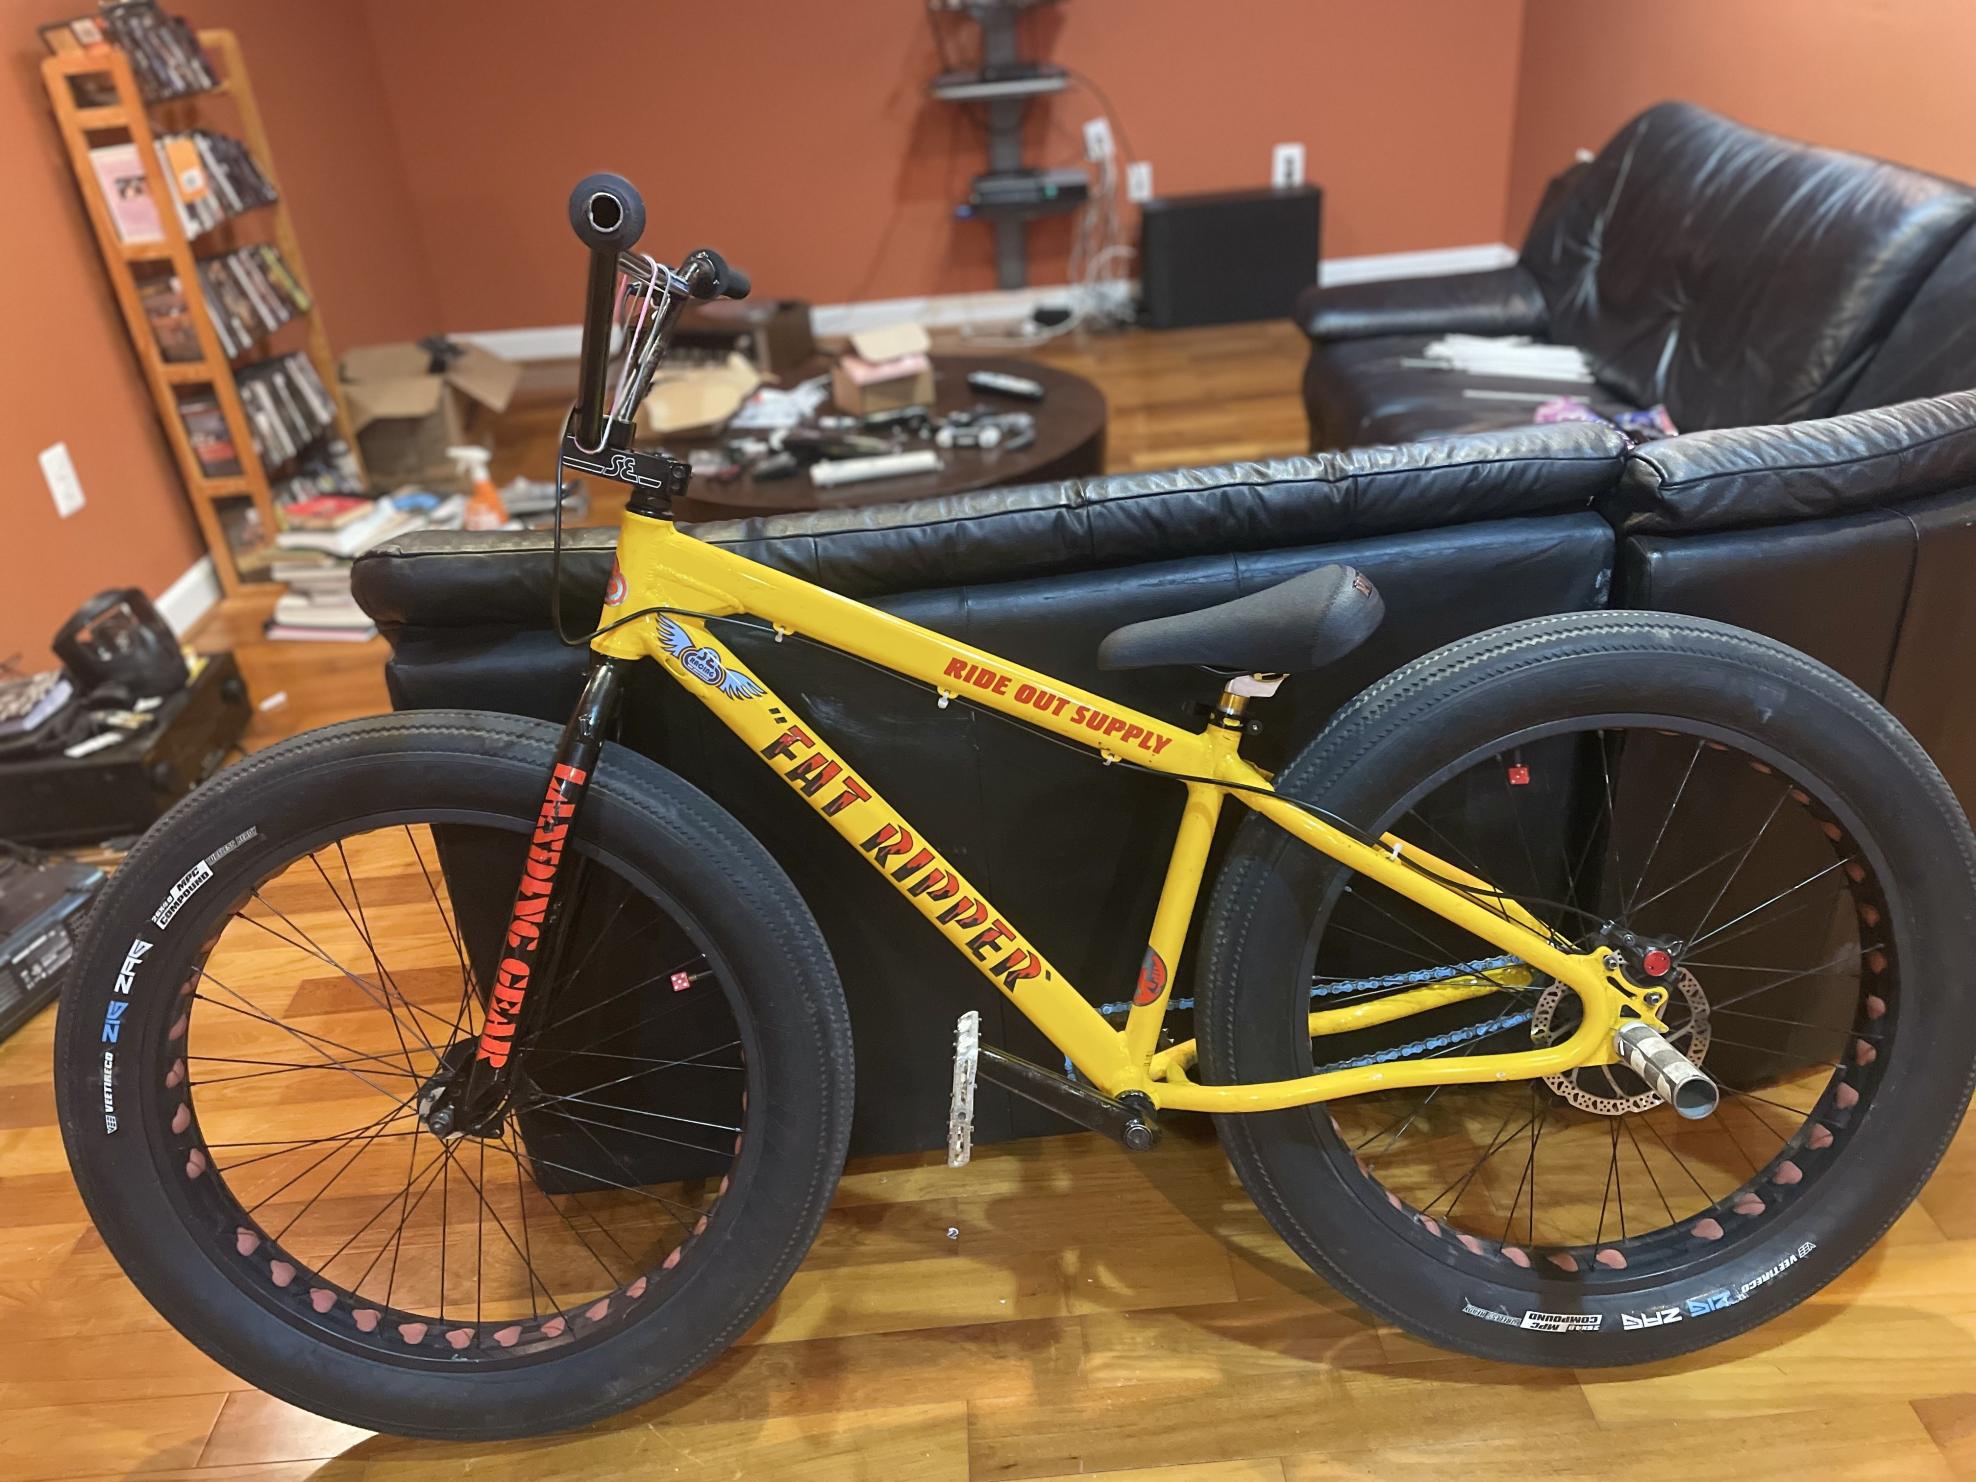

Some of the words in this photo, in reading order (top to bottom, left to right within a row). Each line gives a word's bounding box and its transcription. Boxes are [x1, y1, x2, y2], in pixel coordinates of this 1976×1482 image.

[602, 454, 639, 483] SE
[689, 656, 714, 678] RACING
[943, 657, 1012, 695] RIDE
[1014, 683, 1071, 717] OUT
[1070, 706, 1173, 755] SUPPLY
[507, 763, 588, 951] LANDING
[158, 870, 211, 927] COMPOUND
[176, 866, 201, 892] MPC
[113, 938, 154, 995] ZAG
[101, 1000, 129, 1043] ZIG
[476, 957, 531, 1068] GEAR
[104, 1051, 115, 1114] VEETIRECO
[1741, 1254, 1798, 1294] VEETIRECO
[1527, 1312, 1599, 1324] COMPOUND
[1621, 1306, 1683, 1331] ZAG
[1686, 1289, 1735, 1318] ZIG
[1529, 1322, 1560, 1332] MPC
